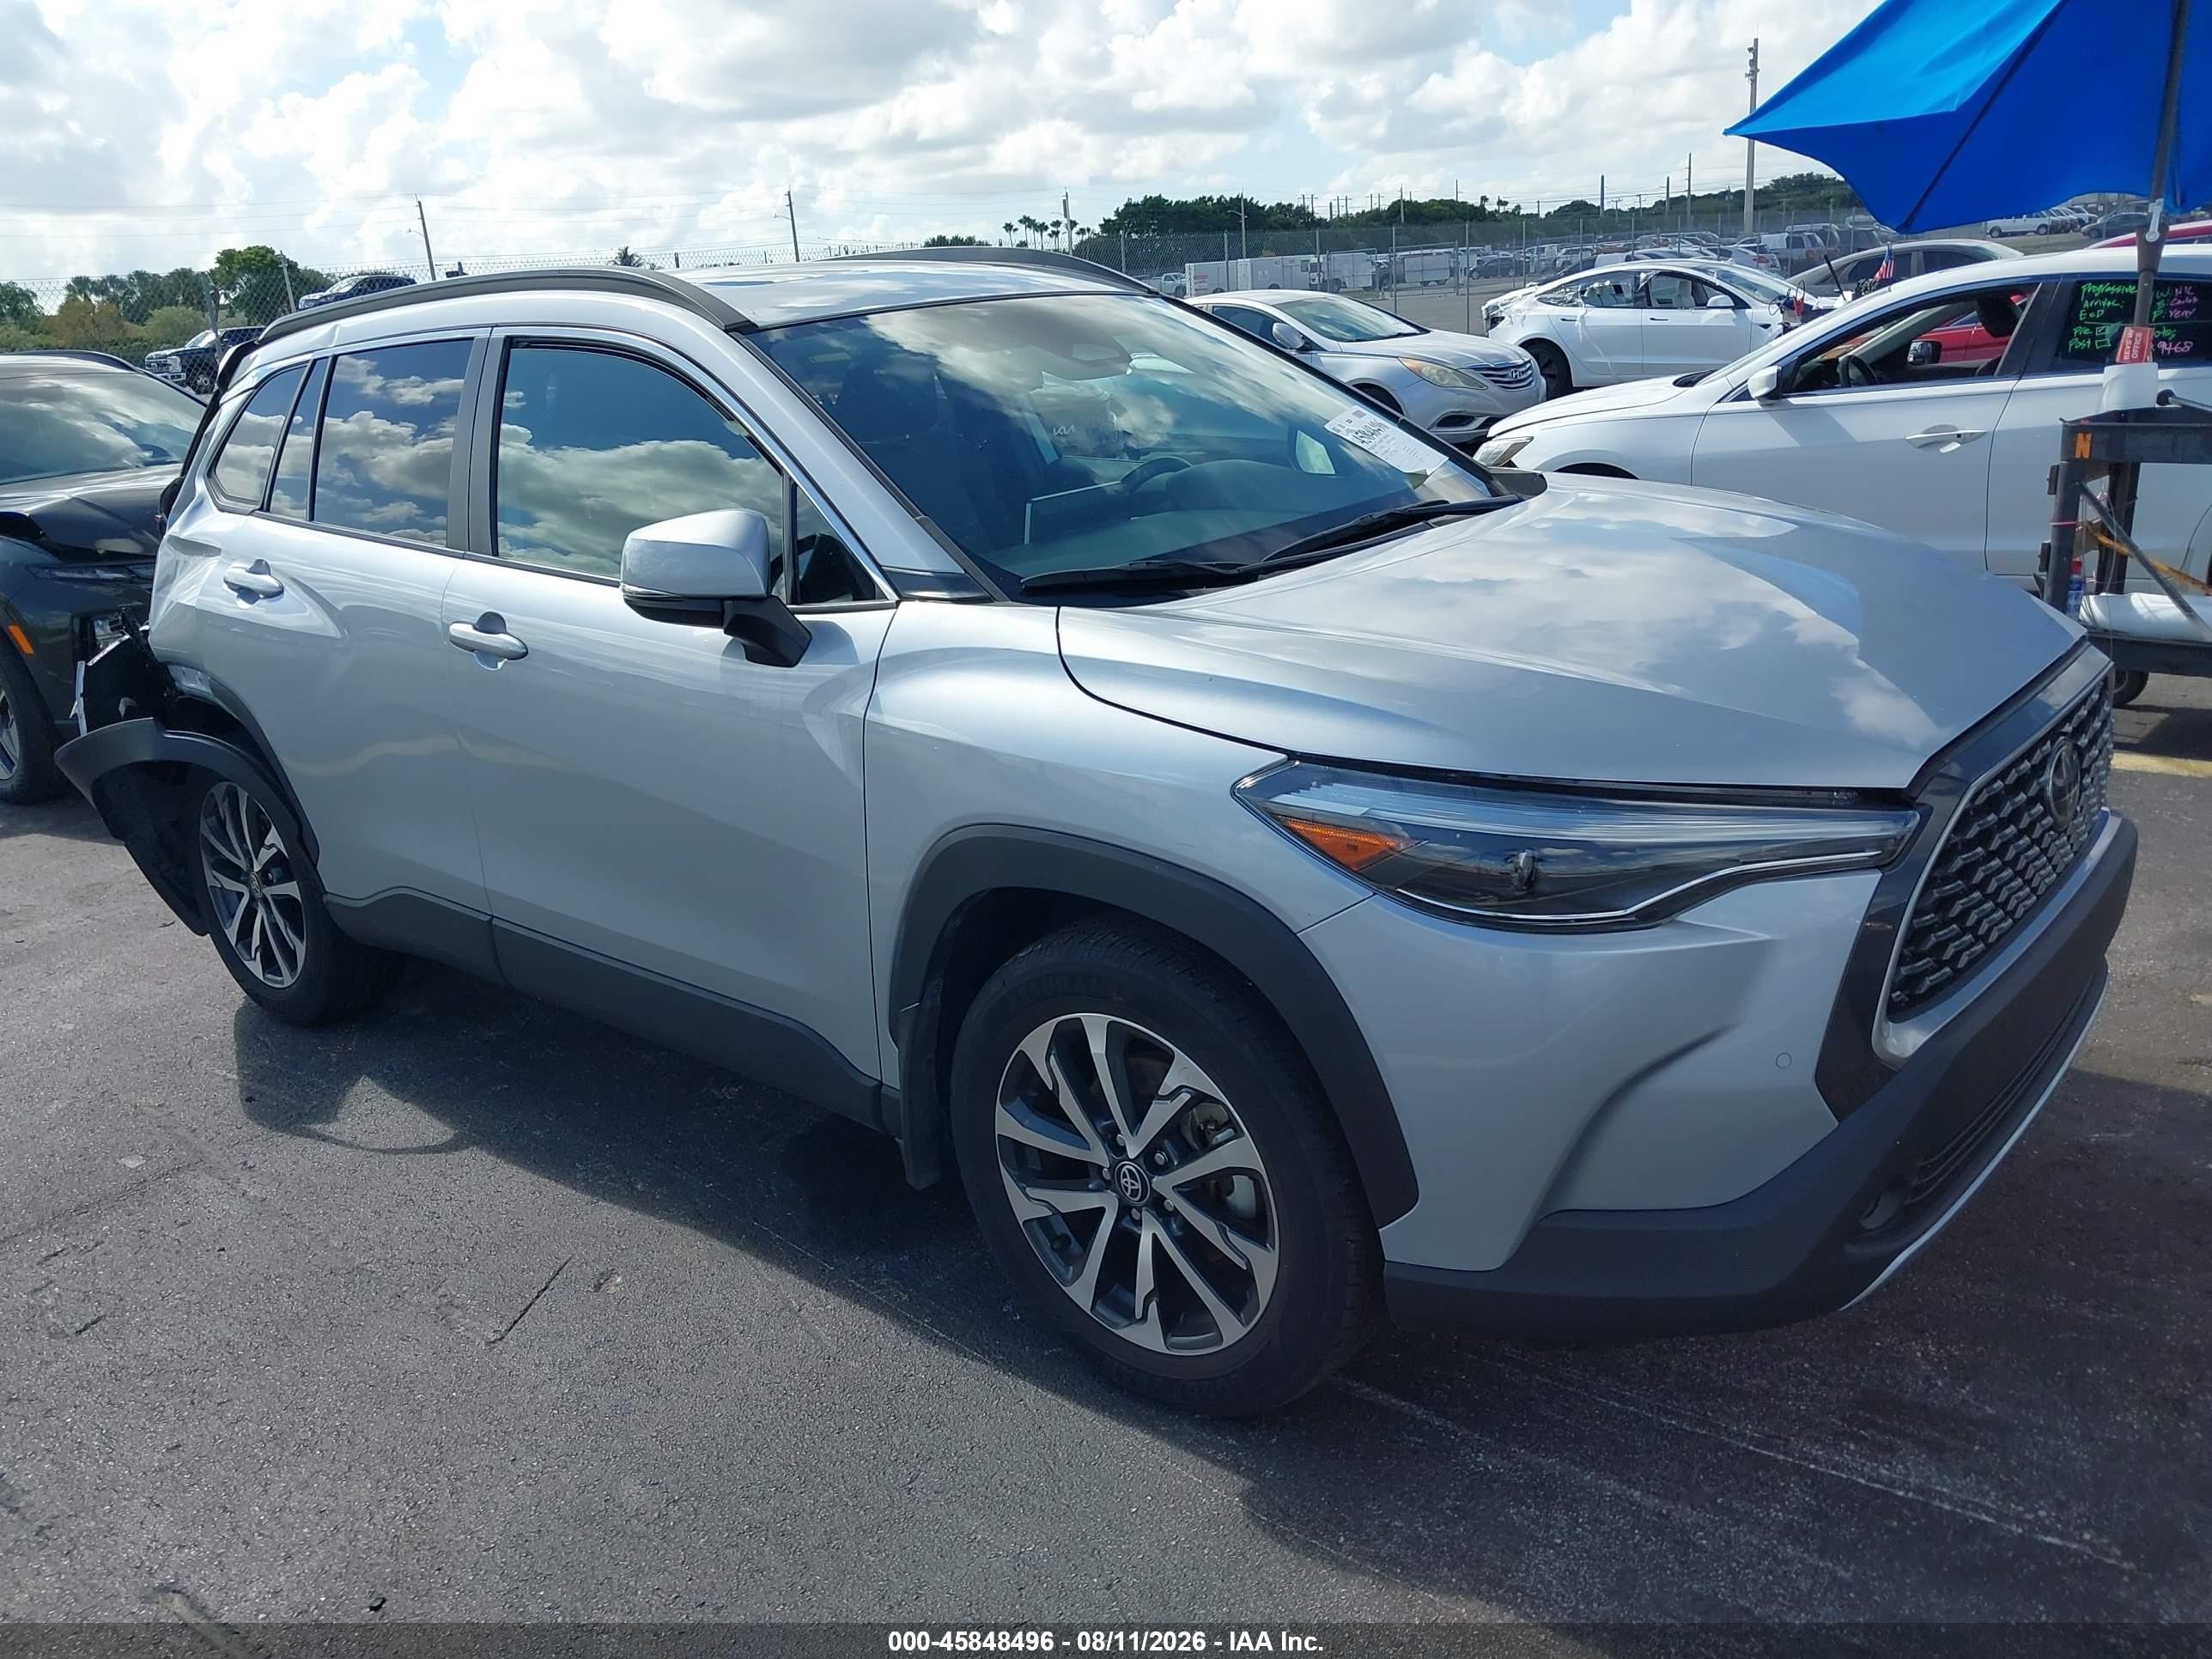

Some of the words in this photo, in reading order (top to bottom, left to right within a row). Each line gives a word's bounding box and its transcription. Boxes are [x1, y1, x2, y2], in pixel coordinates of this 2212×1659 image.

[2131, 331, 2142, 359] OFFICE
[2157, 341, 2193, 356] 9468
[2075, 433, 2092, 459] N
